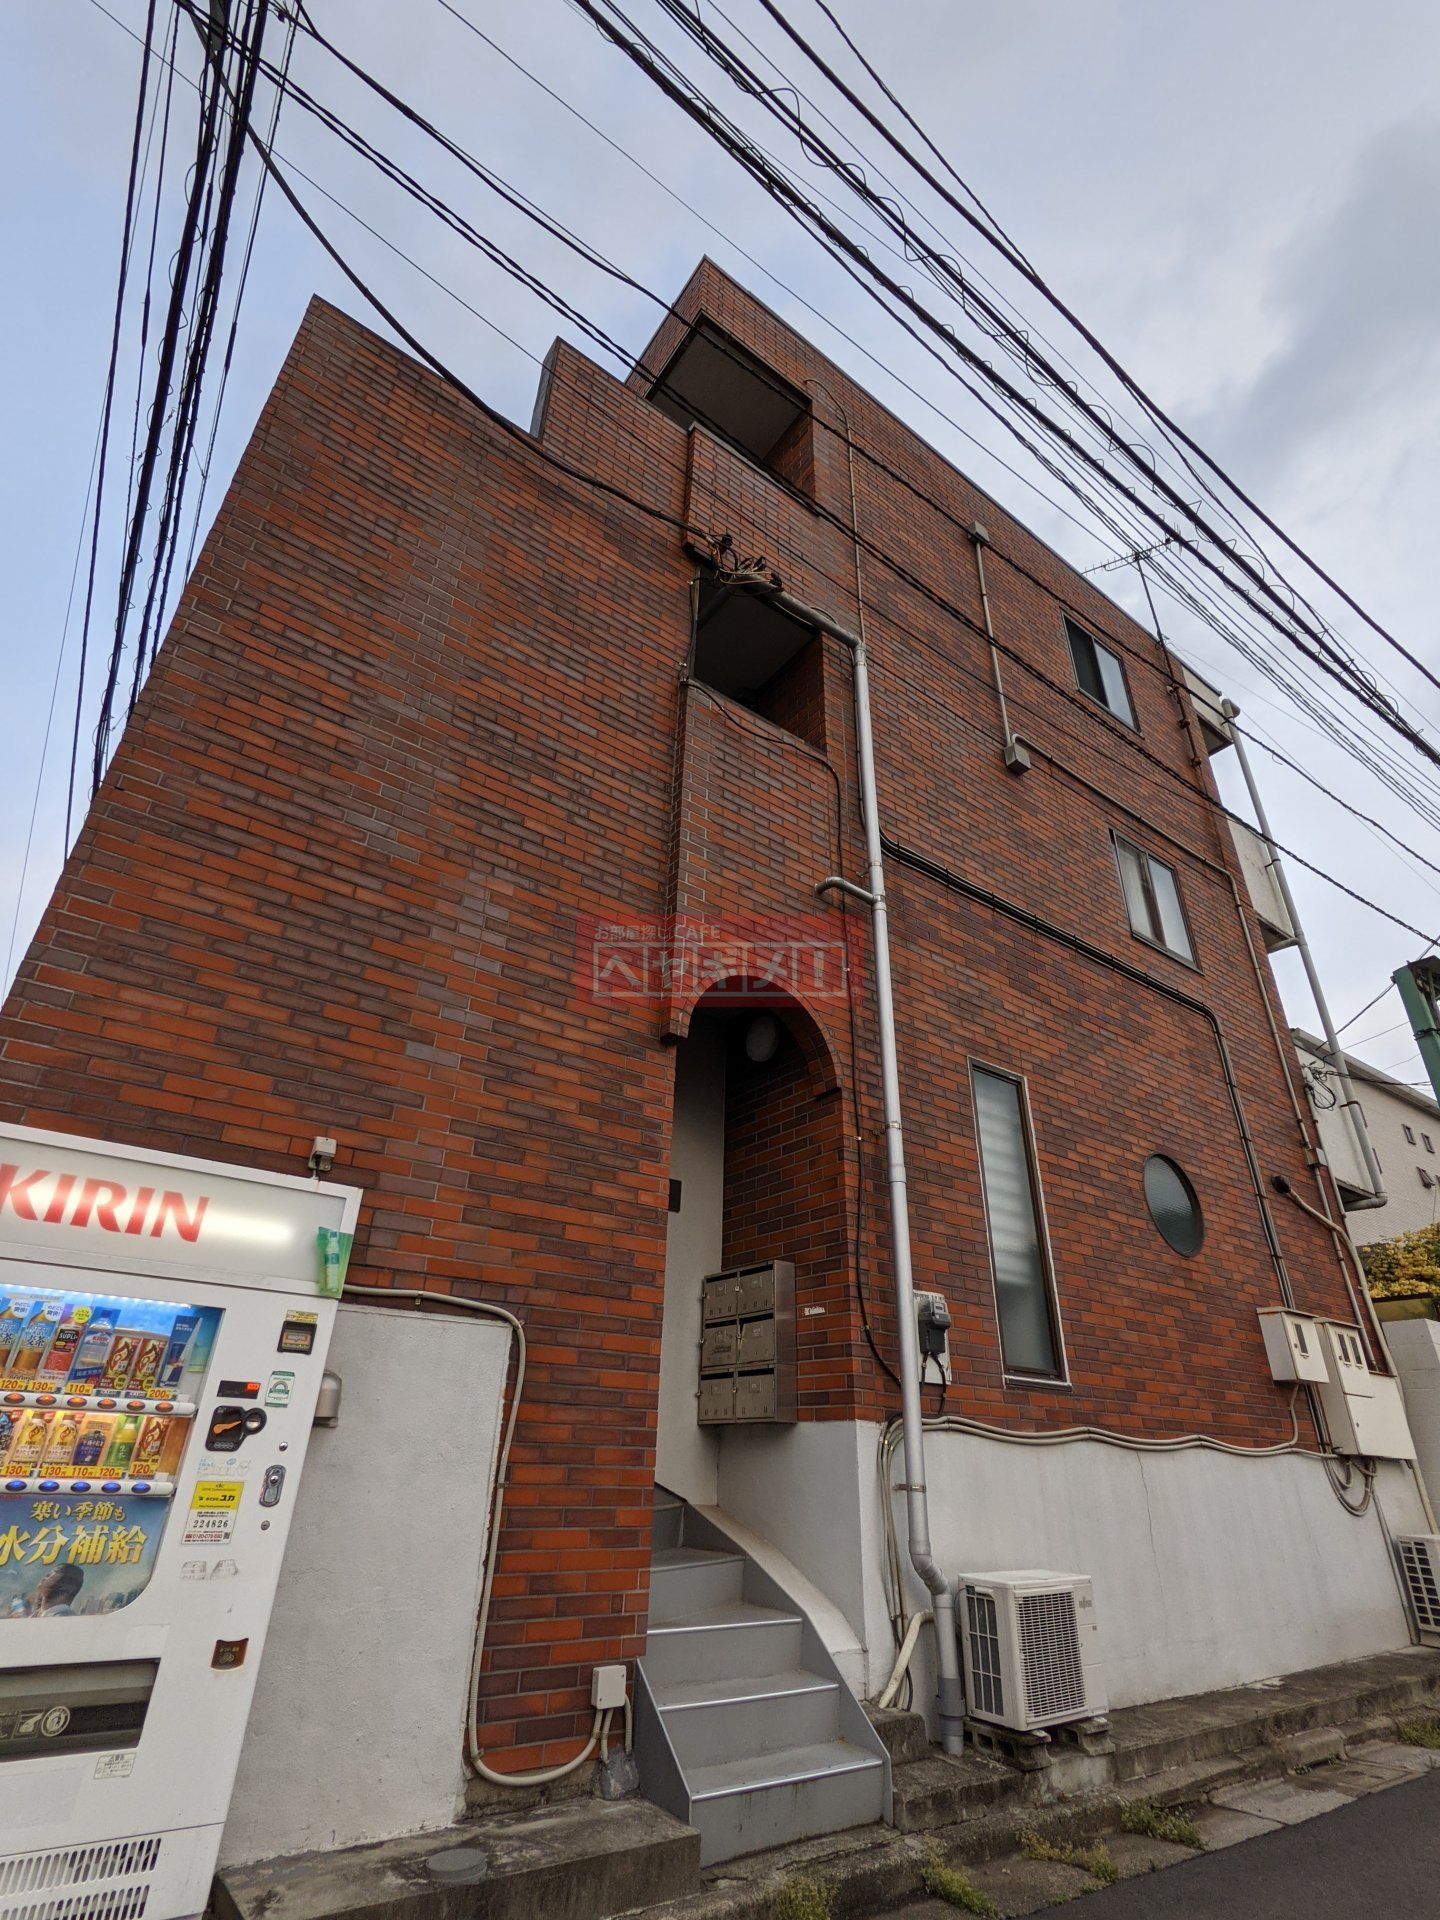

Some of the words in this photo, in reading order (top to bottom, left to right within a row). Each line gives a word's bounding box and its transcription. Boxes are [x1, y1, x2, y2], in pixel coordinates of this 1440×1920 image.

[0, 1163, 210, 1243] KIRIN
[30, 1501, 126, 1522] 寒い季節も
[193, 1519, 229, 1529] 224826
[0, 1524, 148, 1566] 水分補給
